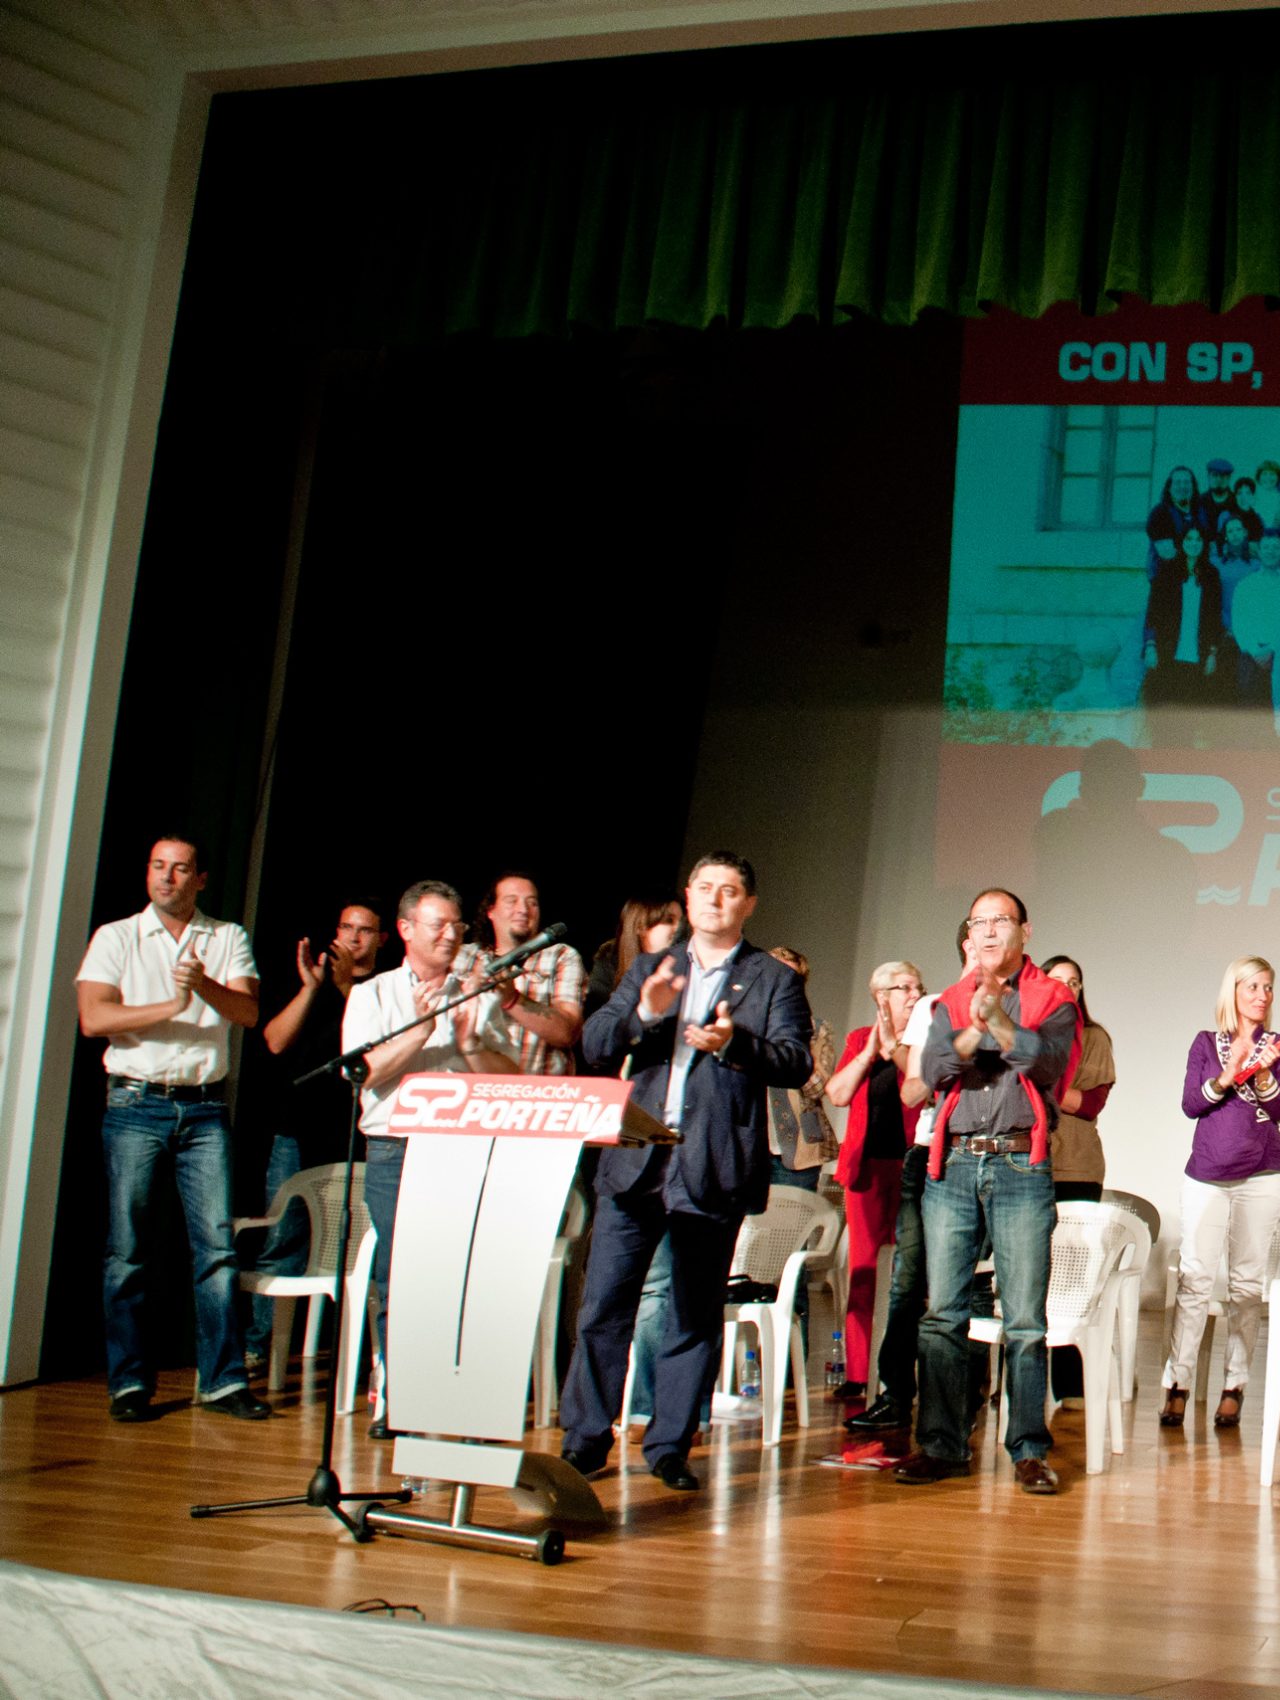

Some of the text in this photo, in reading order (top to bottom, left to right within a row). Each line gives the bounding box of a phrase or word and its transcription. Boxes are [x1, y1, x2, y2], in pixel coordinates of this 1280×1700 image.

[1058, 342, 1167, 382] CON
[1186, 342, 1263, 389] SP,
[471, 1082, 581, 1098] SEGREGACIÓN
[458, 1095, 622, 1133] PORTEÑA
